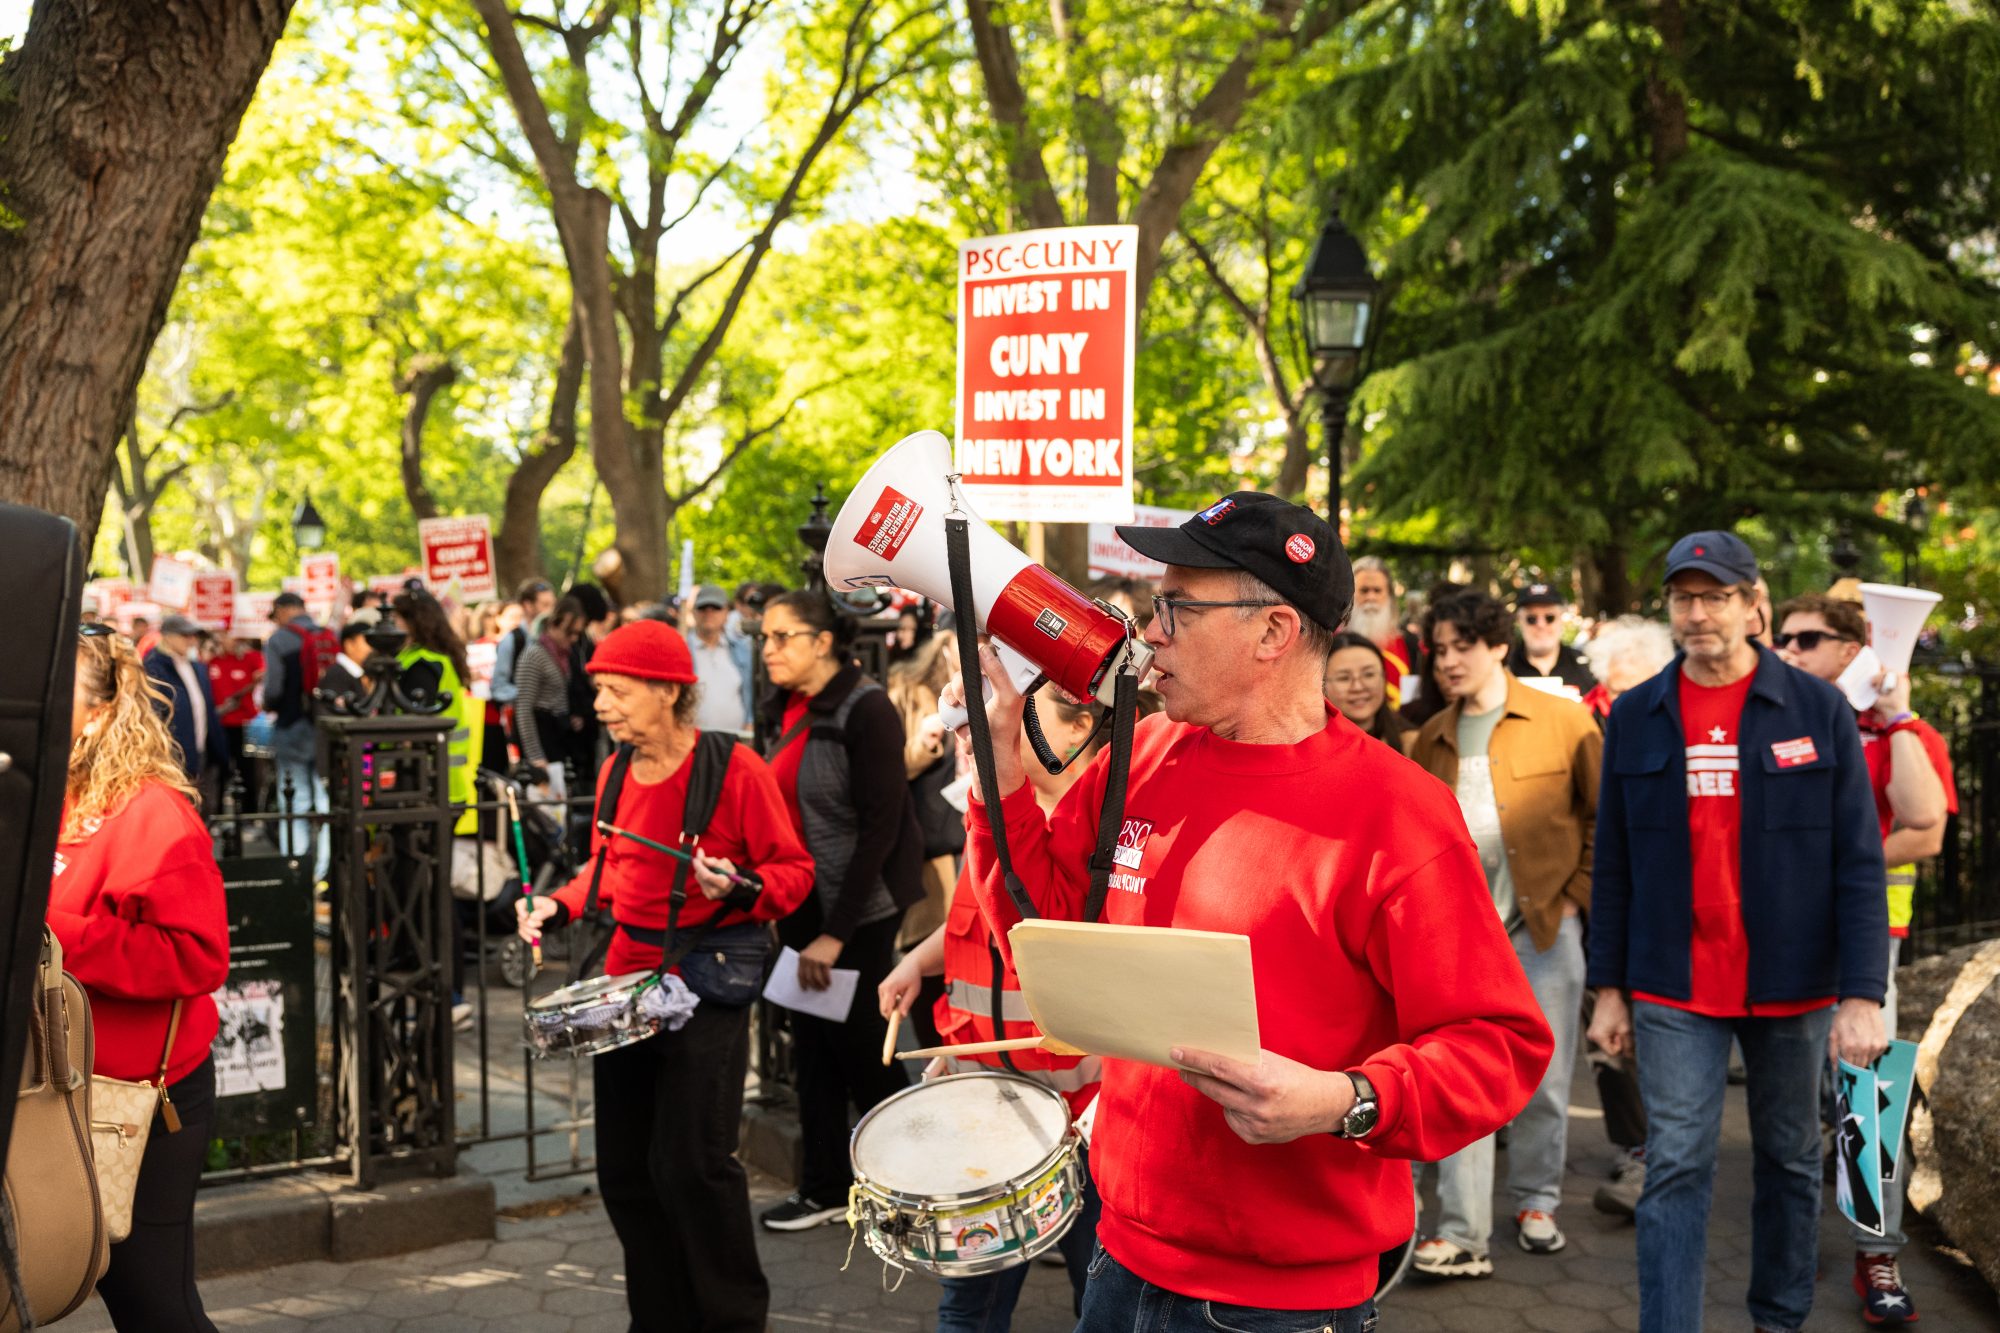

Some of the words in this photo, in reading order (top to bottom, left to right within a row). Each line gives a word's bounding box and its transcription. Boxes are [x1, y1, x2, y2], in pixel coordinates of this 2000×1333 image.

[966, 239, 1124, 276] PSC-CUNY
[972, 280, 1062, 318] INVEST
[1071, 277, 1111, 312] IN
[989, 332, 1089, 378] CUNY
[973, 388, 1061, 422] INVEST
[1069, 388, 1105, 420] IN
[962, 438, 1023, 476] NEW
[1025, 437, 1122, 477] YORK
[868, 502, 902, 551] BILLIONAIRES
[888, 500, 913, 537] WORKERS
[1207, 501, 1238, 526] CUNY
[875, 535, 892, 555] OVER
[1288, 542, 1309, 560] PROUD
[1294, 535, 1313, 554] UNION
[1118, 820, 1152, 850] PSC
